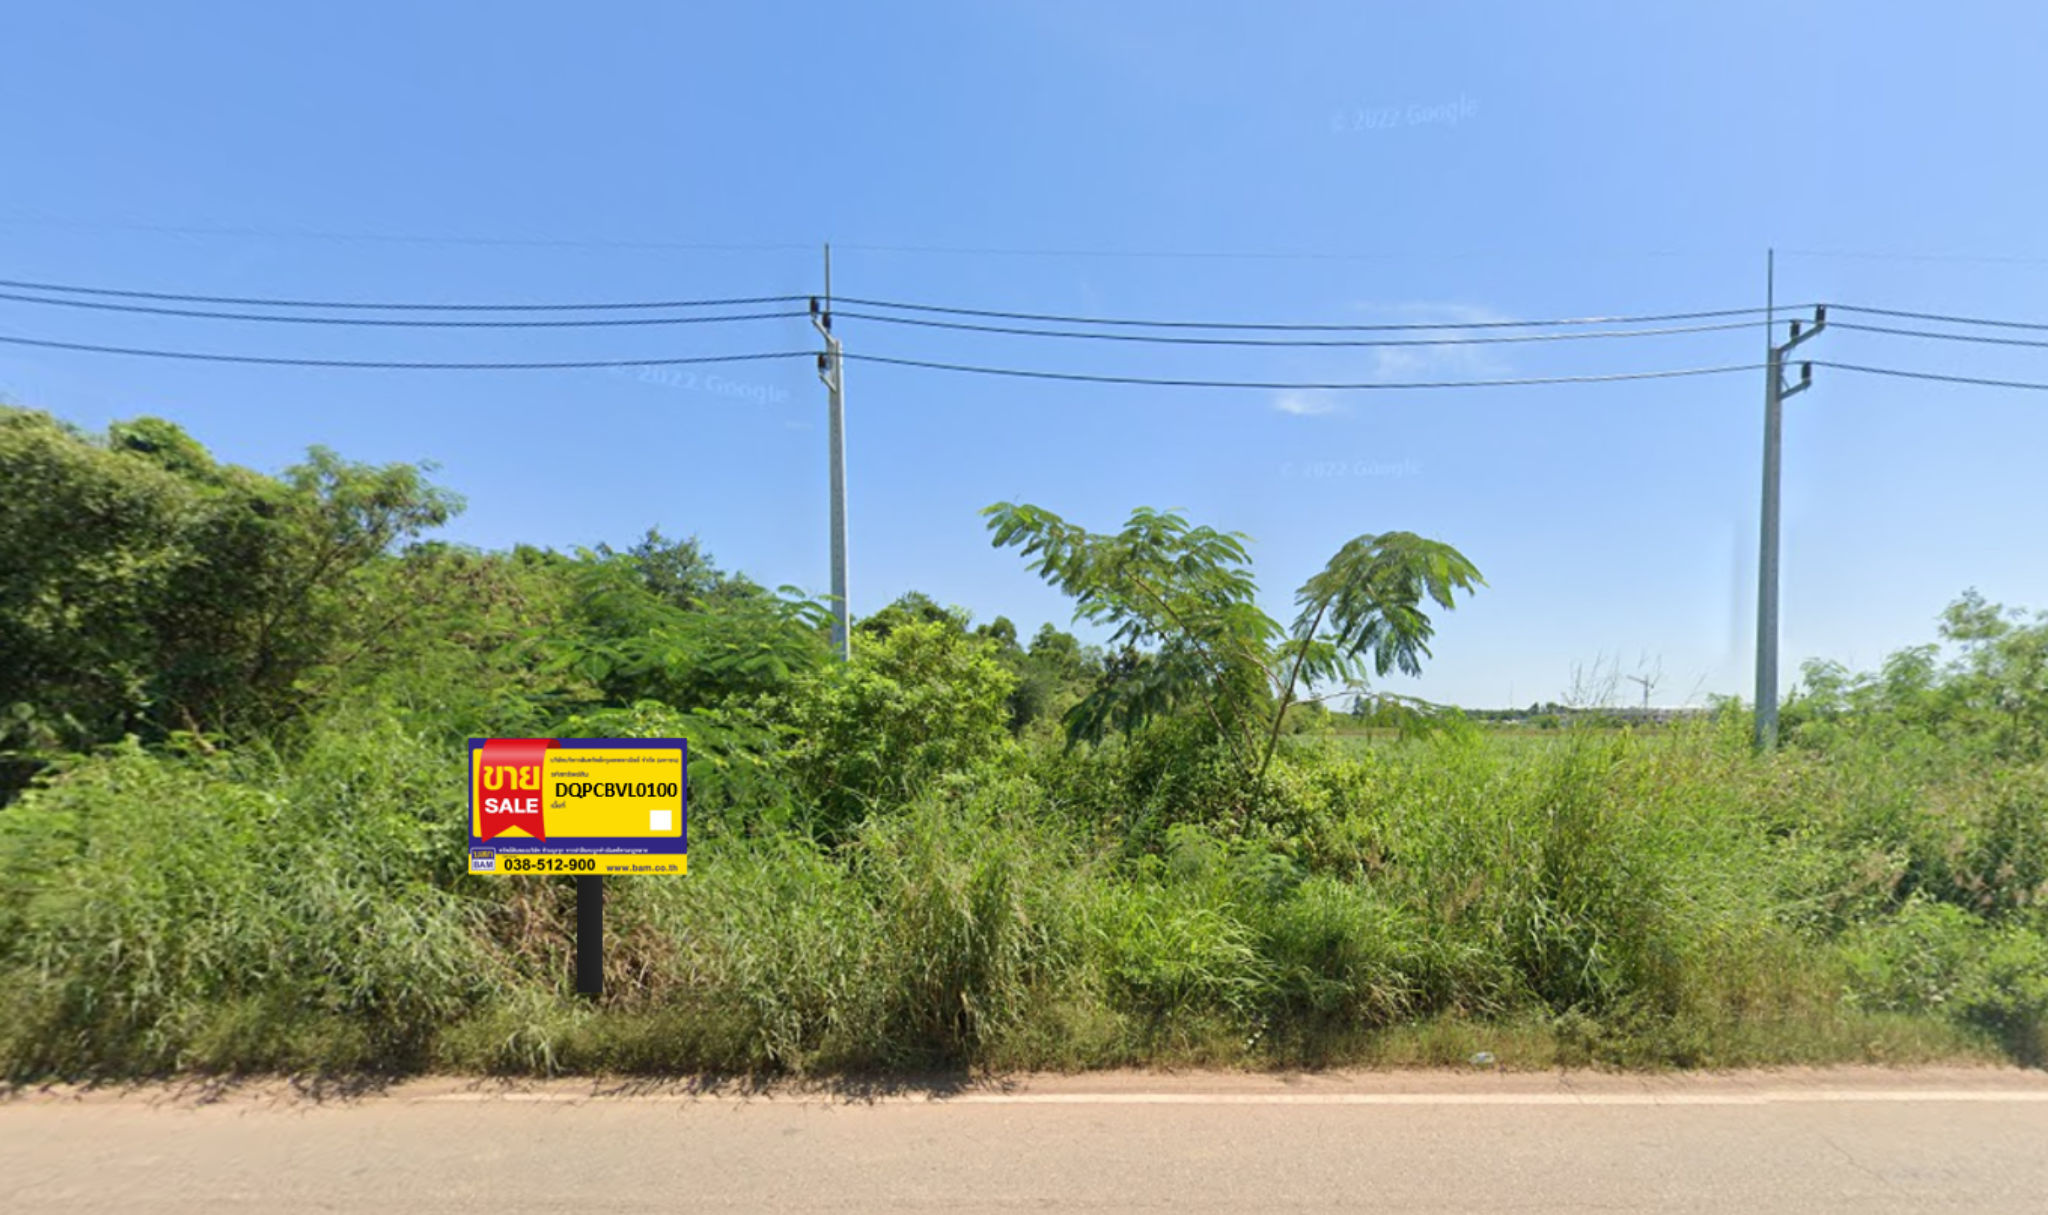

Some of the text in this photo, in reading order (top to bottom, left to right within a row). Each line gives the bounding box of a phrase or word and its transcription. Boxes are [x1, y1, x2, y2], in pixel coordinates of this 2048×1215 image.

[483, 765, 541, 790] ขาย
[555, 782, 678, 799] DQPCBVL0100
[484, 797, 539, 814] SALE
[473, 860, 494, 869] BAM
[504, 858, 596, 871] 038-512-900
[606, 863, 679, 873] www.bam.co.th
